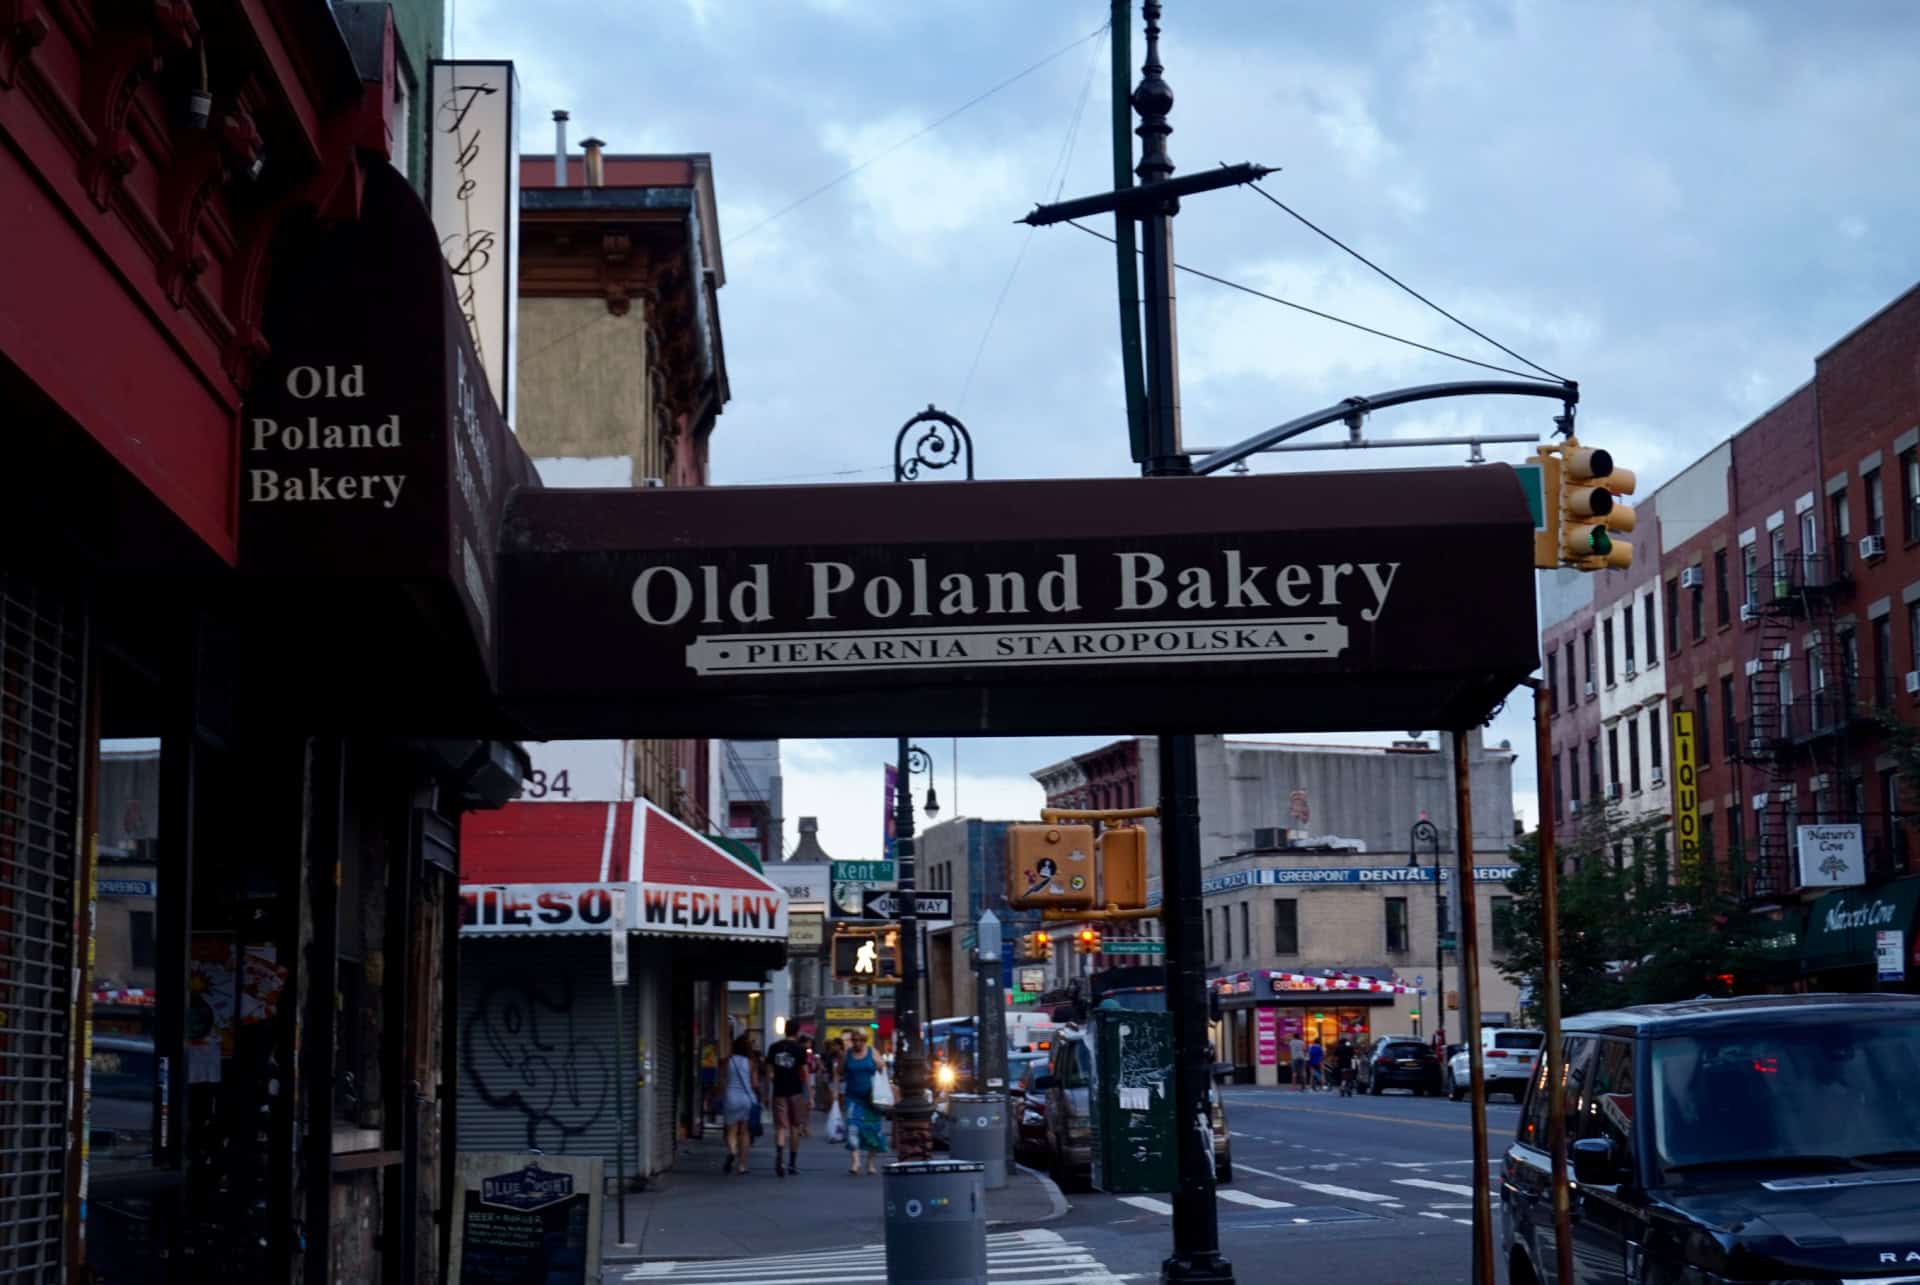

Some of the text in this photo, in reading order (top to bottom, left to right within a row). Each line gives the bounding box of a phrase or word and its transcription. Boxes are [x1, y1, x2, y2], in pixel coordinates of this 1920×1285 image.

[436, 83, 498, 201] The
[286, 364, 366, 400] Old
[252, 414, 402, 451] Poland
[248, 468, 407, 508] Bakery
[631, 549, 1401, 626] Old Poland Bakery
[746, 629, 1289, 664] PIEKARNIA STAROPOLSKA
[521, 769, 572, 799] 34
[1676, 715, 1697, 868] LIQUOR
[1807, 826, 1857, 841] Nature's
[1819, 841, 1845, 852] Cove
[837, 863, 875, 880] Kent
[1278, 870, 1351, 882] GREENPOINT
[1359, 869, 1430, 881] DENTAL
[1472, 867, 1520, 880] EDIC
[1880, 1251, 1920, 1263] RA
